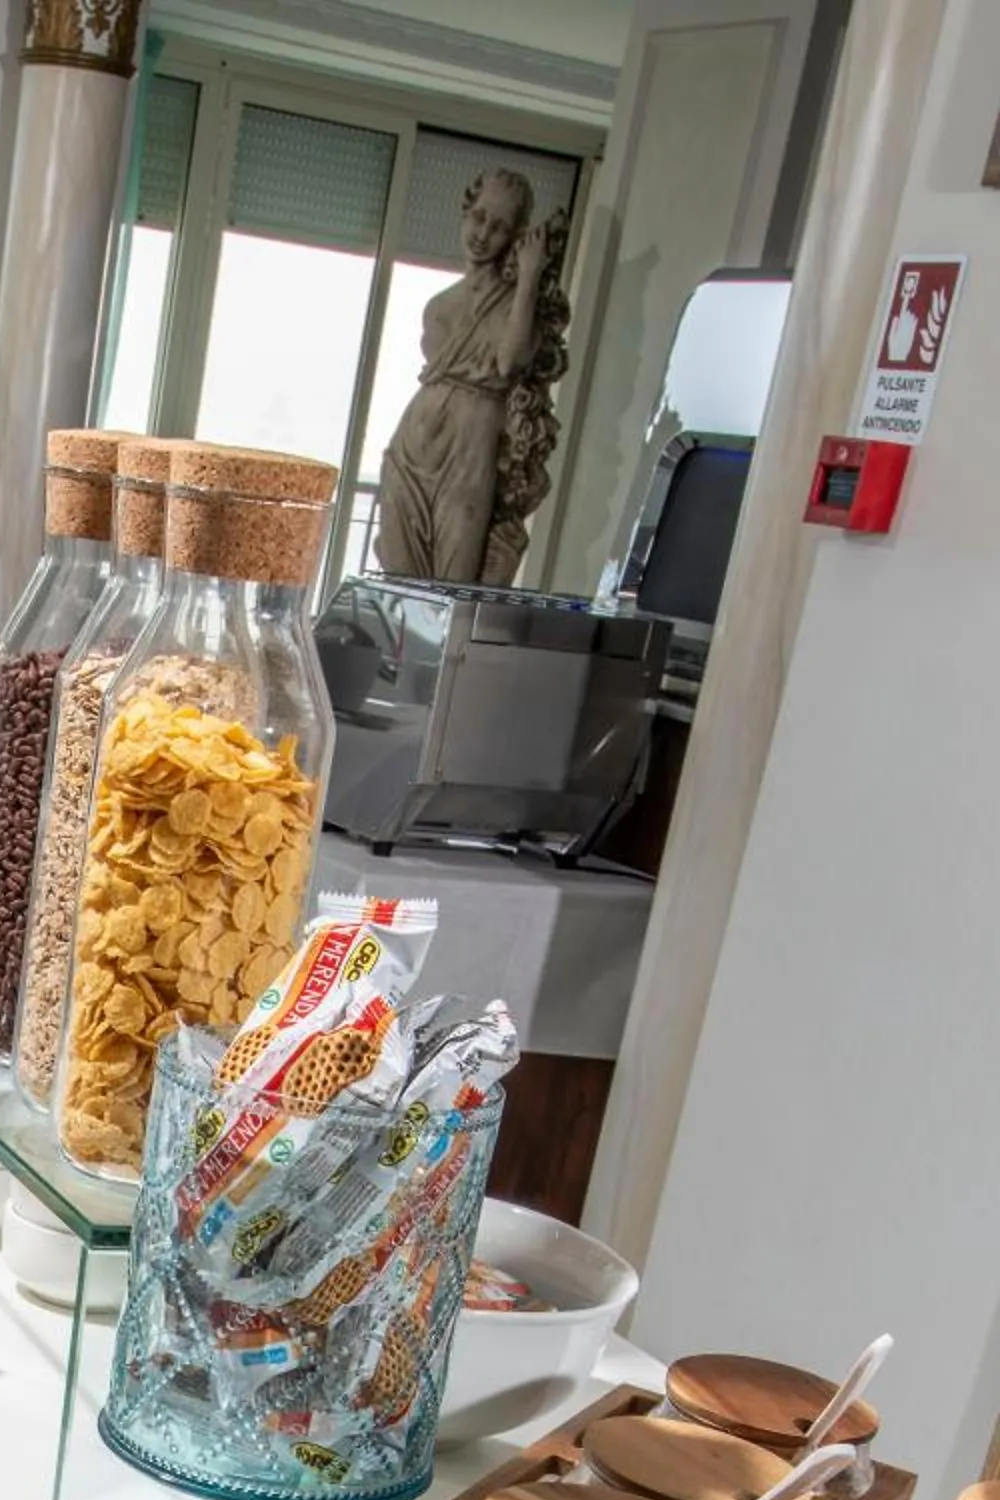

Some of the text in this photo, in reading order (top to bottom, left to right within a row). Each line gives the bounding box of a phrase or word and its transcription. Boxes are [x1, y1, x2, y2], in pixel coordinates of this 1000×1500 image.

[877, 376, 926, 393] PULSANTE
[874, 396, 919, 413] ALLARME
[862, 415, 921, 434] ANTINCENDIO
